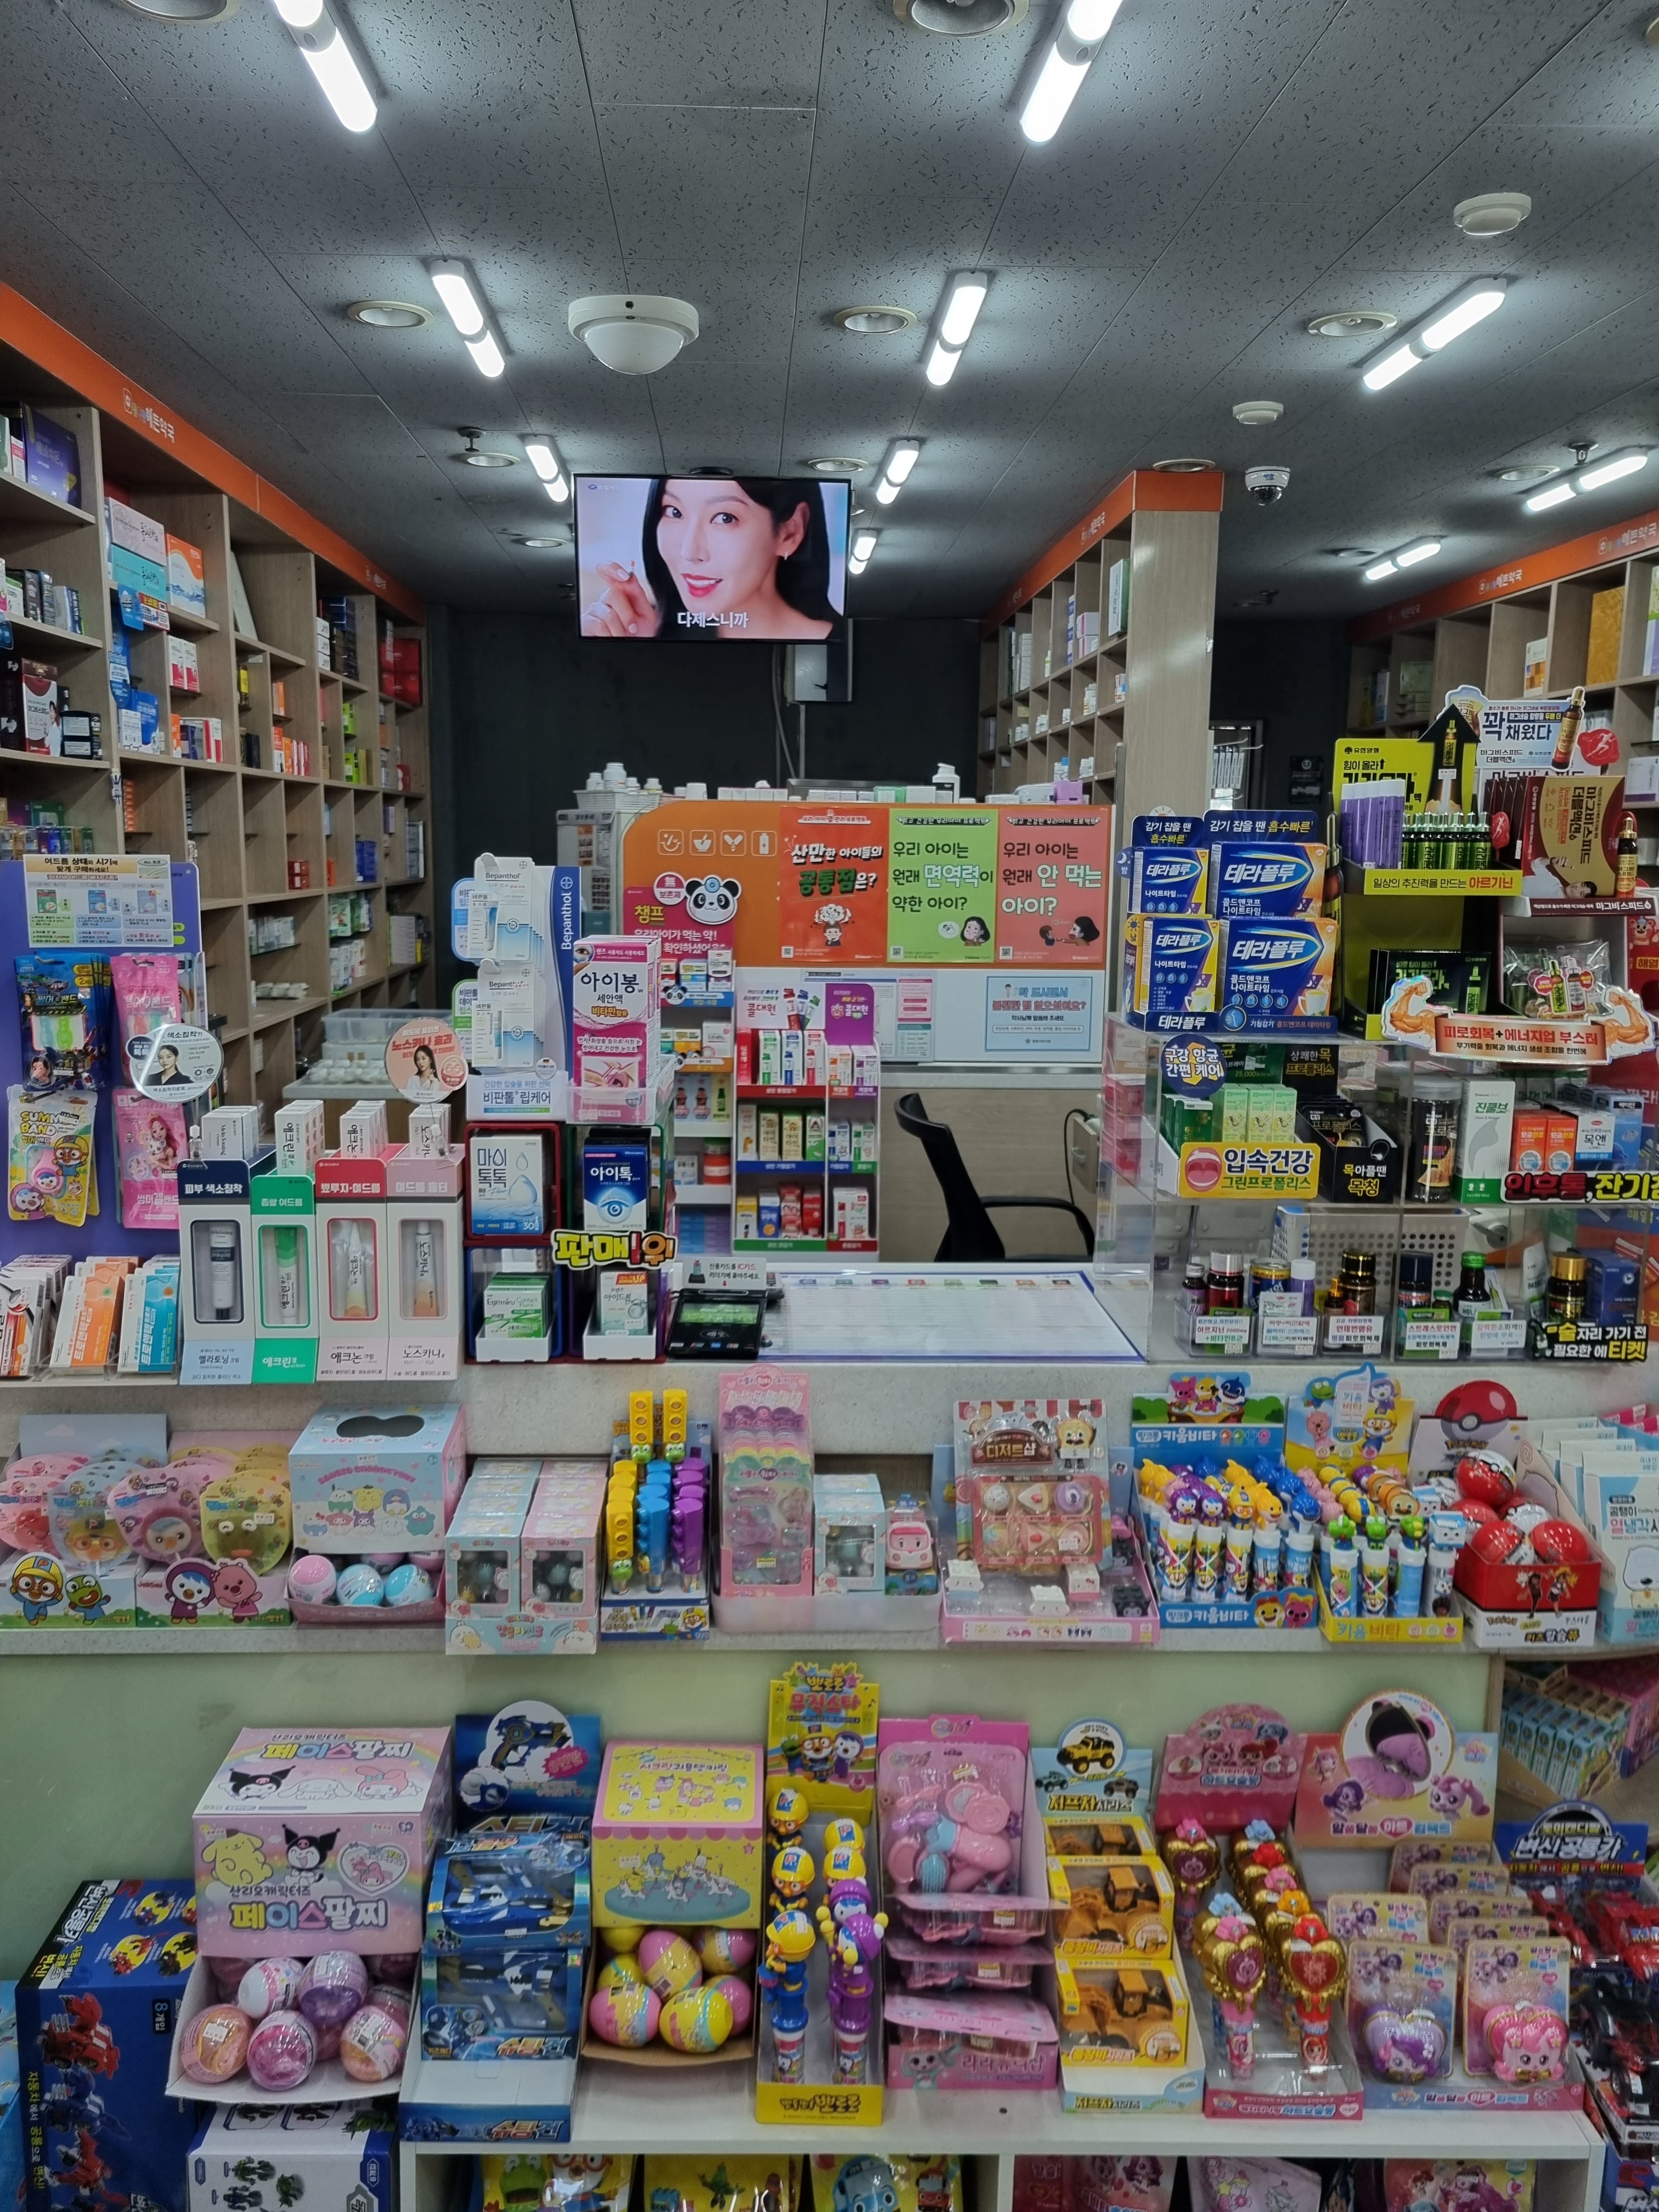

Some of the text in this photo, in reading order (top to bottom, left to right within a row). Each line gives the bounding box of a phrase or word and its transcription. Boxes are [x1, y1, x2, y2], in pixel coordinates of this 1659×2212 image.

[677, 611, 748, 629] 다제스니까
[1482, 712, 1506, 741] 꽉
[1505, 724, 1552, 741] 채웠다
[1344, 760, 1379, 771] 힘이 올라
[1569, 787, 1585, 834] 더블액션
[917, 816, 934, 825] 건강한
[1026, 816, 1044, 825] 건강한
[1146, 821, 1192, 833] 감기 잡을 땐
[1210, 820, 1266, 832] 감기 잡을 땐
[1580, 787, 1597, 865] 마그비스피드
[791, 844, 883, 864] 산만한 아이들의
[893, 842, 969, 859] 우리 아이는
[1003, 842, 1079, 859] 우리 아이는
[1121, 866, 1128, 874] 밤
[1146, 863, 1190, 876] 테라플루
[1224, 864, 1296, 883] 테라플루
[799, 868, 877, 895] 공통점은?
[892, 865, 993, 888] 원래 면역력이
[1003, 865, 1102, 888] 원래 안 먹는
[1373, 877, 1513, 889] 일상의 추진력을 만드는 아르기닌
[1145, 889, 1176, 898] 나이트타임
[892, 896, 967, 912] 약한 아이?
[1001, 896, 1057, 916] 아이?
[1222, 898, 1261, 907] 콜드앤코프
[1595, 902, 1645, 910] 마그비스피드
[634, 905, 665, 924] 챔프
[1222, 907, 1261, 917] 나이트타임
[561, 892, 573, 950] Bepanthol
[634, 930, 718, 942] 우리아이가 먹는 약!
[1130, 933, 1137, 943] 낮
[1156, 934, 1201, 947] 테라플루
[1232, 940, 1305, 960] 테라플루
[1155, 961, 1187, 969] 나이트타임
[580, 973, 639, 994] 아이봉
[1230, 974, 1270, 984] 콜드앤코프
[1018, 987, 1068, 997] 약 드시면서
[1231, 983, 1270, 994] 나이트타임
[37, 994, 78, 1005] 썸머 밴드
[597, 994, 623, 1004] 세안액
[1022, 1000, 1032, 1011] 점
[591, 1006, 616, 1017] 비타민
[747, 1003, 776, 1018] 콜대원
[1158, 1015, 1206, 1029] 테라플루
[1276, 1020, 1331, 1029] 콜드앤코프 데이타임
[434, 1034, 453, 1046] 효과
[1443, 1025, 1599, 1045] 피로회복+에너지업 부스터
[1165, 1048, 1218, 1063] 구강 항균
[1290, 1048, 1331, 1062] 상쾌한 목
[1485, 1043, 1505, 1052] 회복과
[1530, 1045, 1543, 1053] 생성
[1544, 1045, 1565, 1054] 조합을
[1567, 1047, 1587, 1056] 한번에
[1166, 1064, 1193, 1077] 간편
[1195, 1064, 1222, 1077] 케어
[1285, 1063, 1334, 1076] 프로폴리스
[520, 1091, 551, 1104] 립케어
[20, 1124, 57, 1136] BAND
[37, 1136, 52, 1145] 밴드
[1583, 1134, 1607, 1147] 목앤
[477, 1148, 507, 1167] 마이
[1224, 1148, 1313, 1175] 입속건강
[590, 1166, 633, 1181] 아이톡
[1343, 1165, 1387, 1178] 목아플땐
[478, 1169, 507, 1188] 톡톡
[1221, 1176, 1311, 1191] 그린프로폴리스
[185, 1183, 242, 1194] 피부 색소침착
[396, 1183, 426, 1194] 여드름
[1348, 1179, 1380, 1197] 목청
[1505, 1172, 1593, 1203] 인후통,
[261, 1198, 303, 1207] 좁쌀 여드름
[523, 1222, 535, 1230] 30
[633, 1275, 645, 1284] UP
[487, 1298, 515, 1307] Eyemiru
[1605, 1325, 1646, 1340] 가기 전
[141, 1325, 154, 1365] 트로앤텍
[1553, 1344, 1592, 1358] 필요한
[331, 1352, 363, 1364] 애크논
[403, 1349, 442, 1359] 노스카나
[262, 1357, 291, 1368] 애크린
[1163, 1427, 1217, 1442] 키움비타
[986, 1442, 1036, 1459] 디저트샵
[1194, 1608, 1249, 1623] 키움비타
[806, 1676, 844, 1692] 뽀로로
[791, 1692, 861, 1715] 뮤직스타
[261, 1741, 415, 1760] 페이스팔찌
[1515, 1836, 1622, 1860] 변신공룡카
[229, 1884, 311, 1898] 산리오캐릭터즈
[230, 1895, 390, 1931] 페이스팔찌
